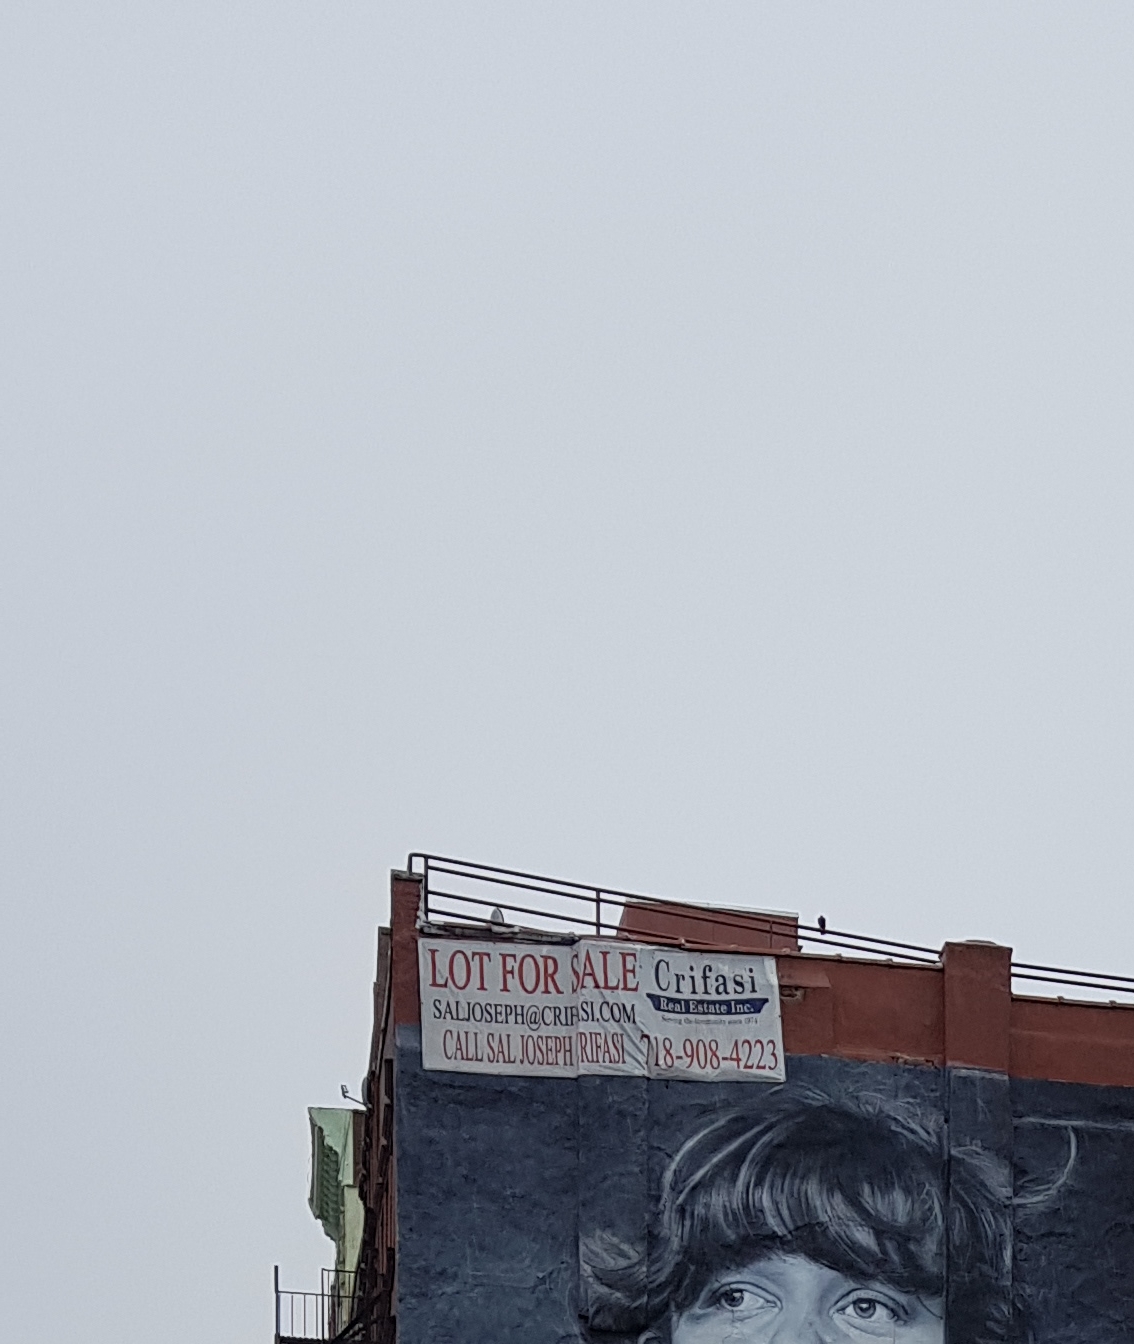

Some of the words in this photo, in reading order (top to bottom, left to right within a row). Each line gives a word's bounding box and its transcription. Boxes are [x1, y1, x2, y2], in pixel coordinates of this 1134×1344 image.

[428, 948, 491, 991] LOT
[499, 953, 564, 995] FOR
[571, 948, 639, 995] SALE
[654, 958, 758, 996] Crifasi
[660, 997, 685, 1013] Real
[689, 1000, 727, 1014] Estate
[730, 1001, 754, 1013] Inc.
[442, 1029, 483, 1062] CALL
[486, 1032, 517, 1064] SAL
[519, 1034, 575, 1067] JOSEPH
[577, 1032, 627, 1065] RIFASI
[640, 1033, 778, 1071] 718-908-4223
